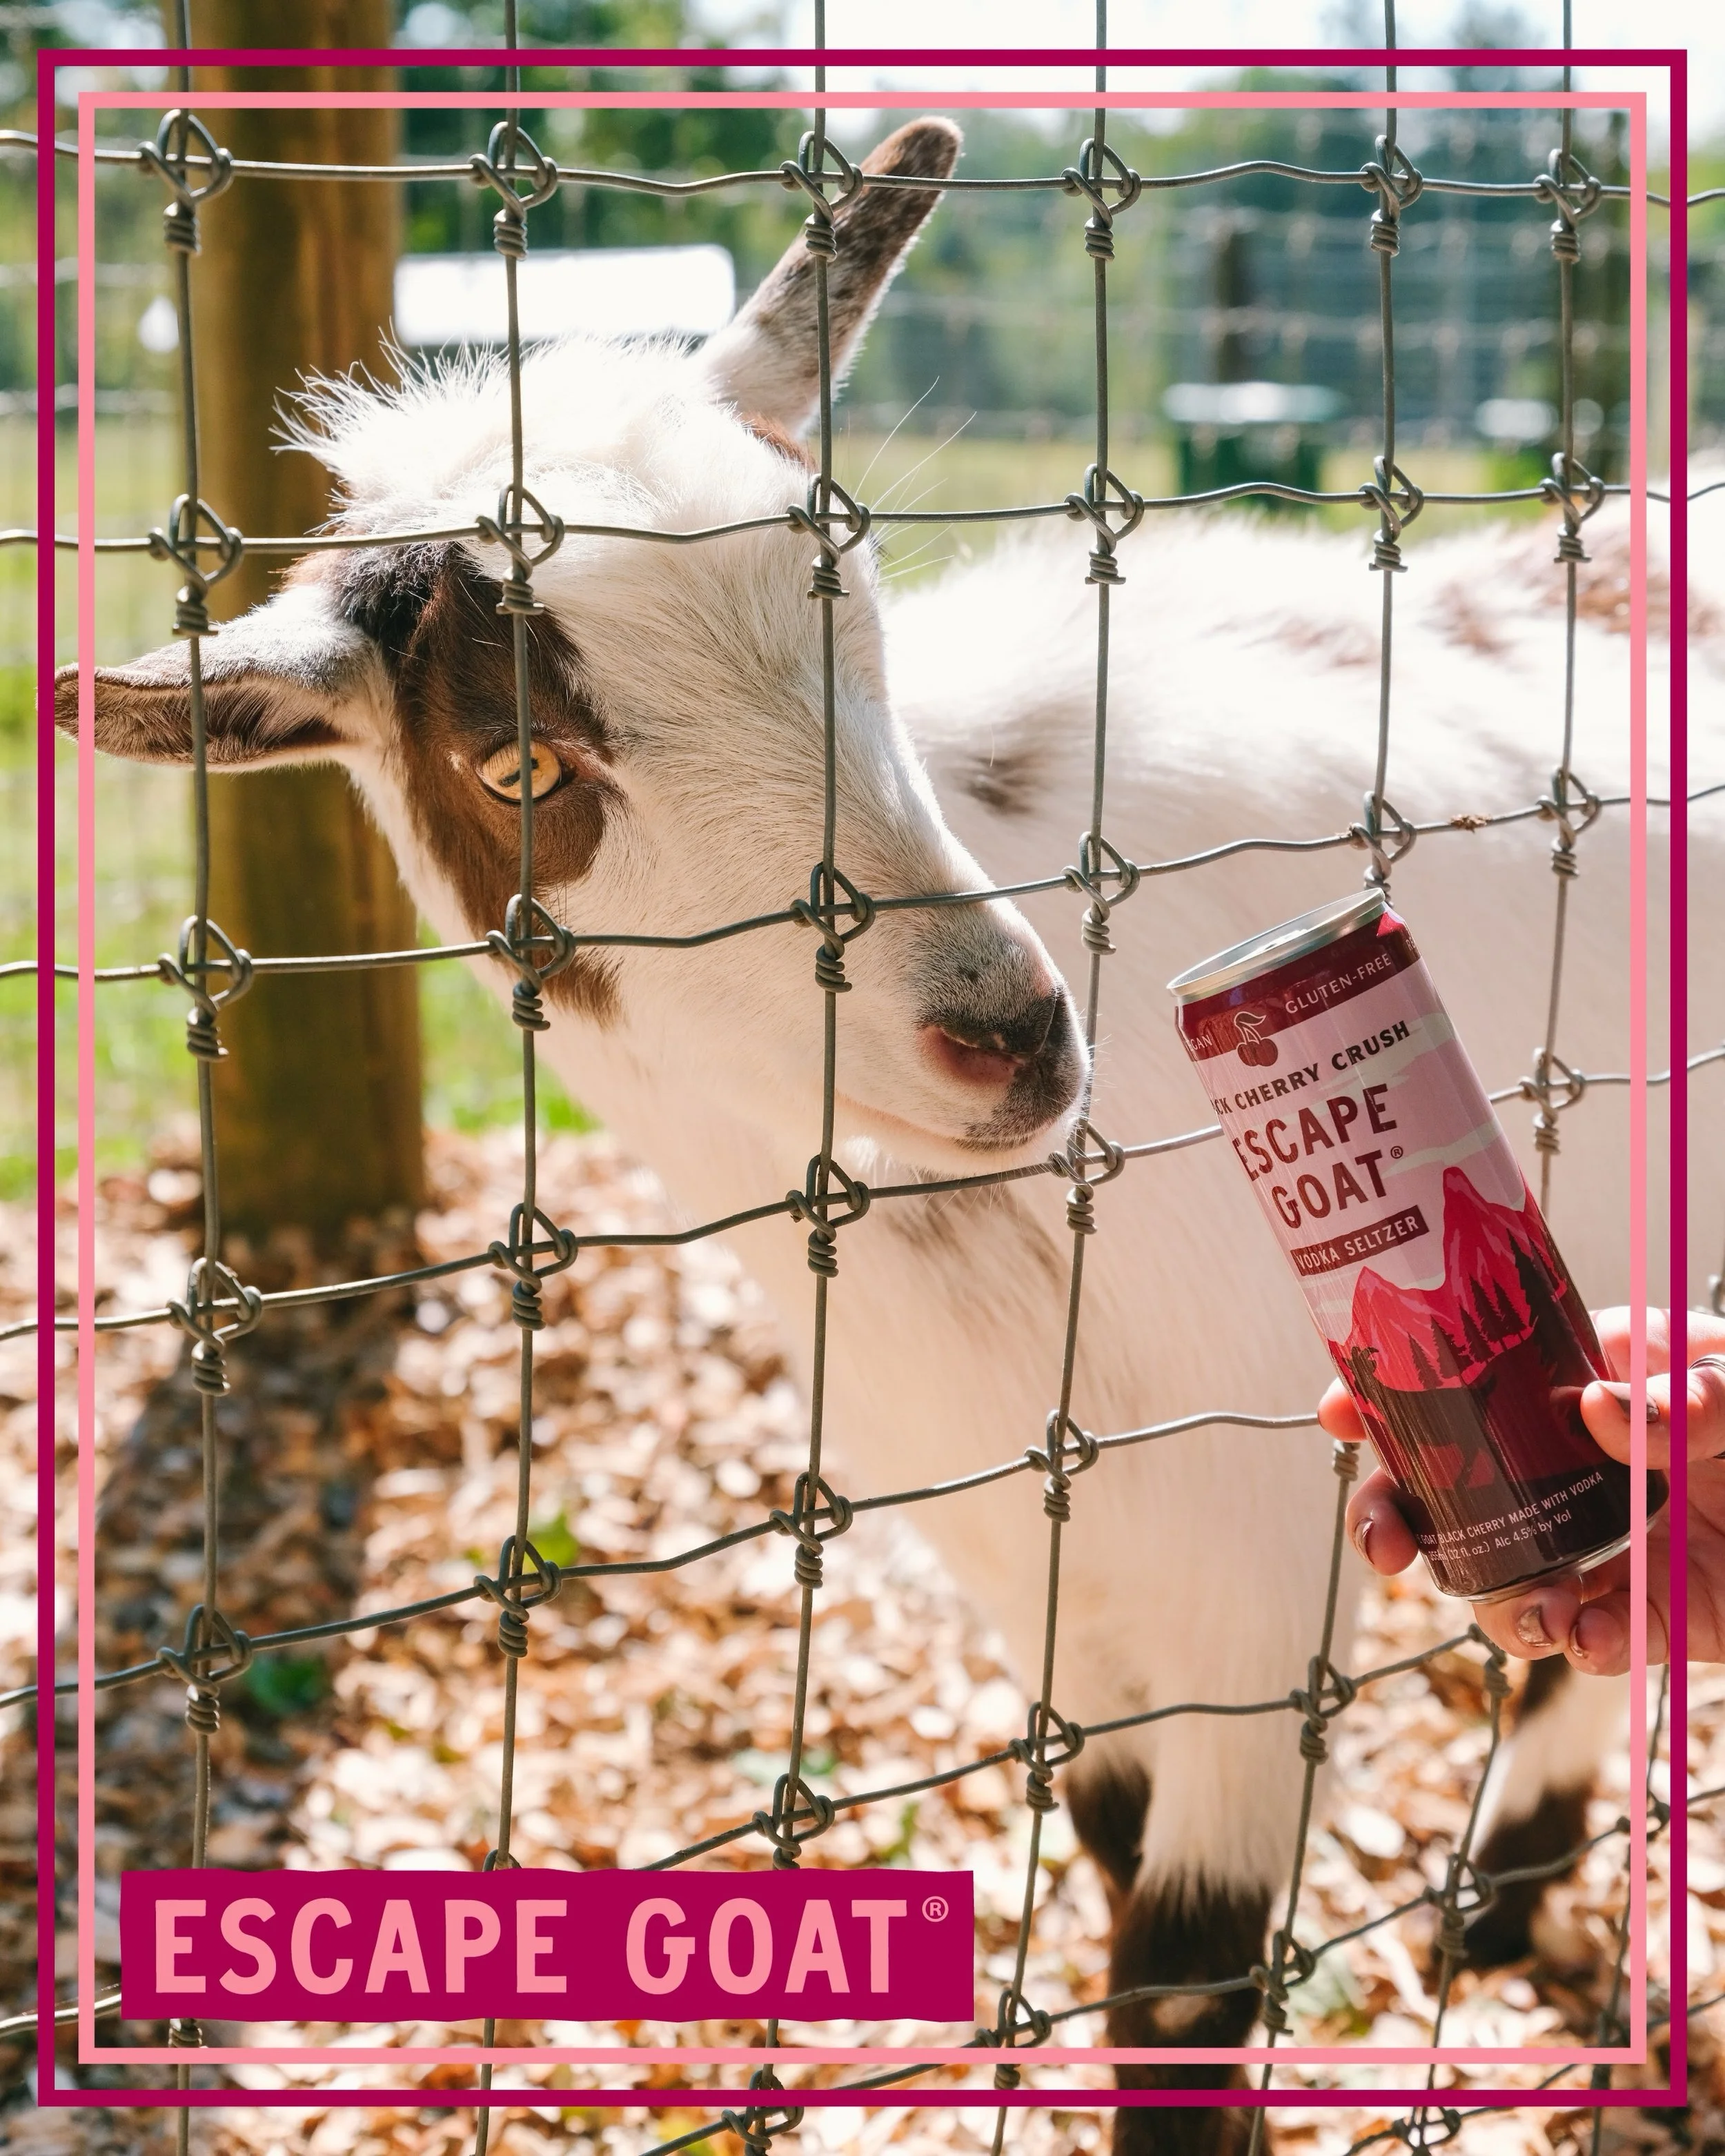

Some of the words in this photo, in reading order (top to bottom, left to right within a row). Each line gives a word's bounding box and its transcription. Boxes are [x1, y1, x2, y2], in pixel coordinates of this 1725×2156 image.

[1285, 953, 1392, 1014] GLUTEN-FREE
[1185, 1034, 1213, 1051] GAN
[1234, 1062, 1321, 1110] CHERRY
[1330, 1020, 1411, 1071] CRUSH
[1232, 1083, 1397, 1182] ESCAPE
[1295, 1247, 1340, 1270] VODKA
[1344, 1215, 1419, 1256] SELTZER
[1437, 1529, 1466, 1544] BLACK
[1466, 1516, 1506, 1538] CHERRY
[1508, 1503, 1540, 1524] MADE
[1541, 1490, 1568, 1510] WITH
[1568, 1472, 1604, 1496] VODKA
[1472, 1541, 1490, 1556] oz.)
[1495, 1536, 1511, 1549] Alc
[1512, 1524, 1537, 1542] 4.5%
[1537, 1521, 1552, 1534] by
[1553, 1509, 1572, 1525] Vol
